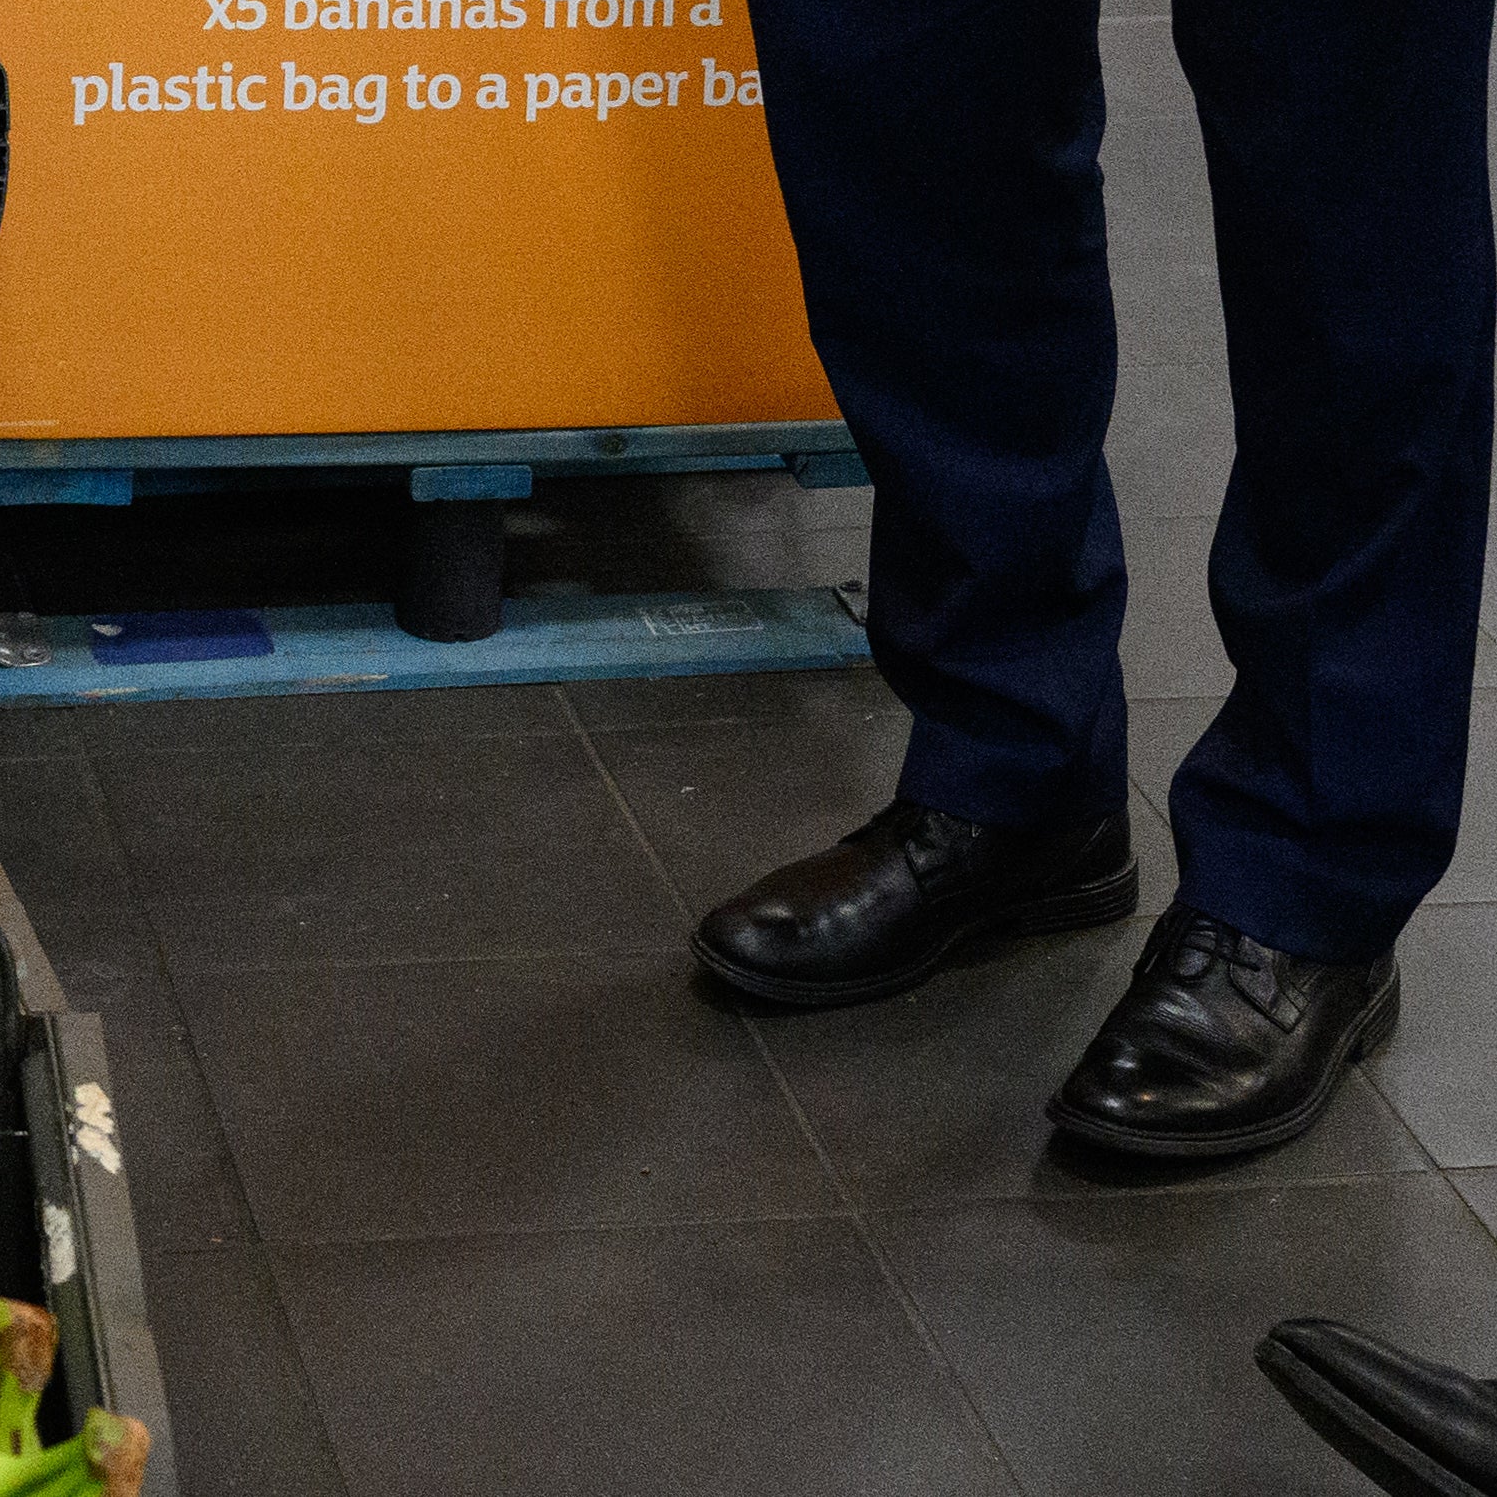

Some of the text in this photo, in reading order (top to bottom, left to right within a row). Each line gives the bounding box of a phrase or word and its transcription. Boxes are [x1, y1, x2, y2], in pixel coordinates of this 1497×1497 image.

[71, 57, 764, 126] plastic bag to a paper ba
